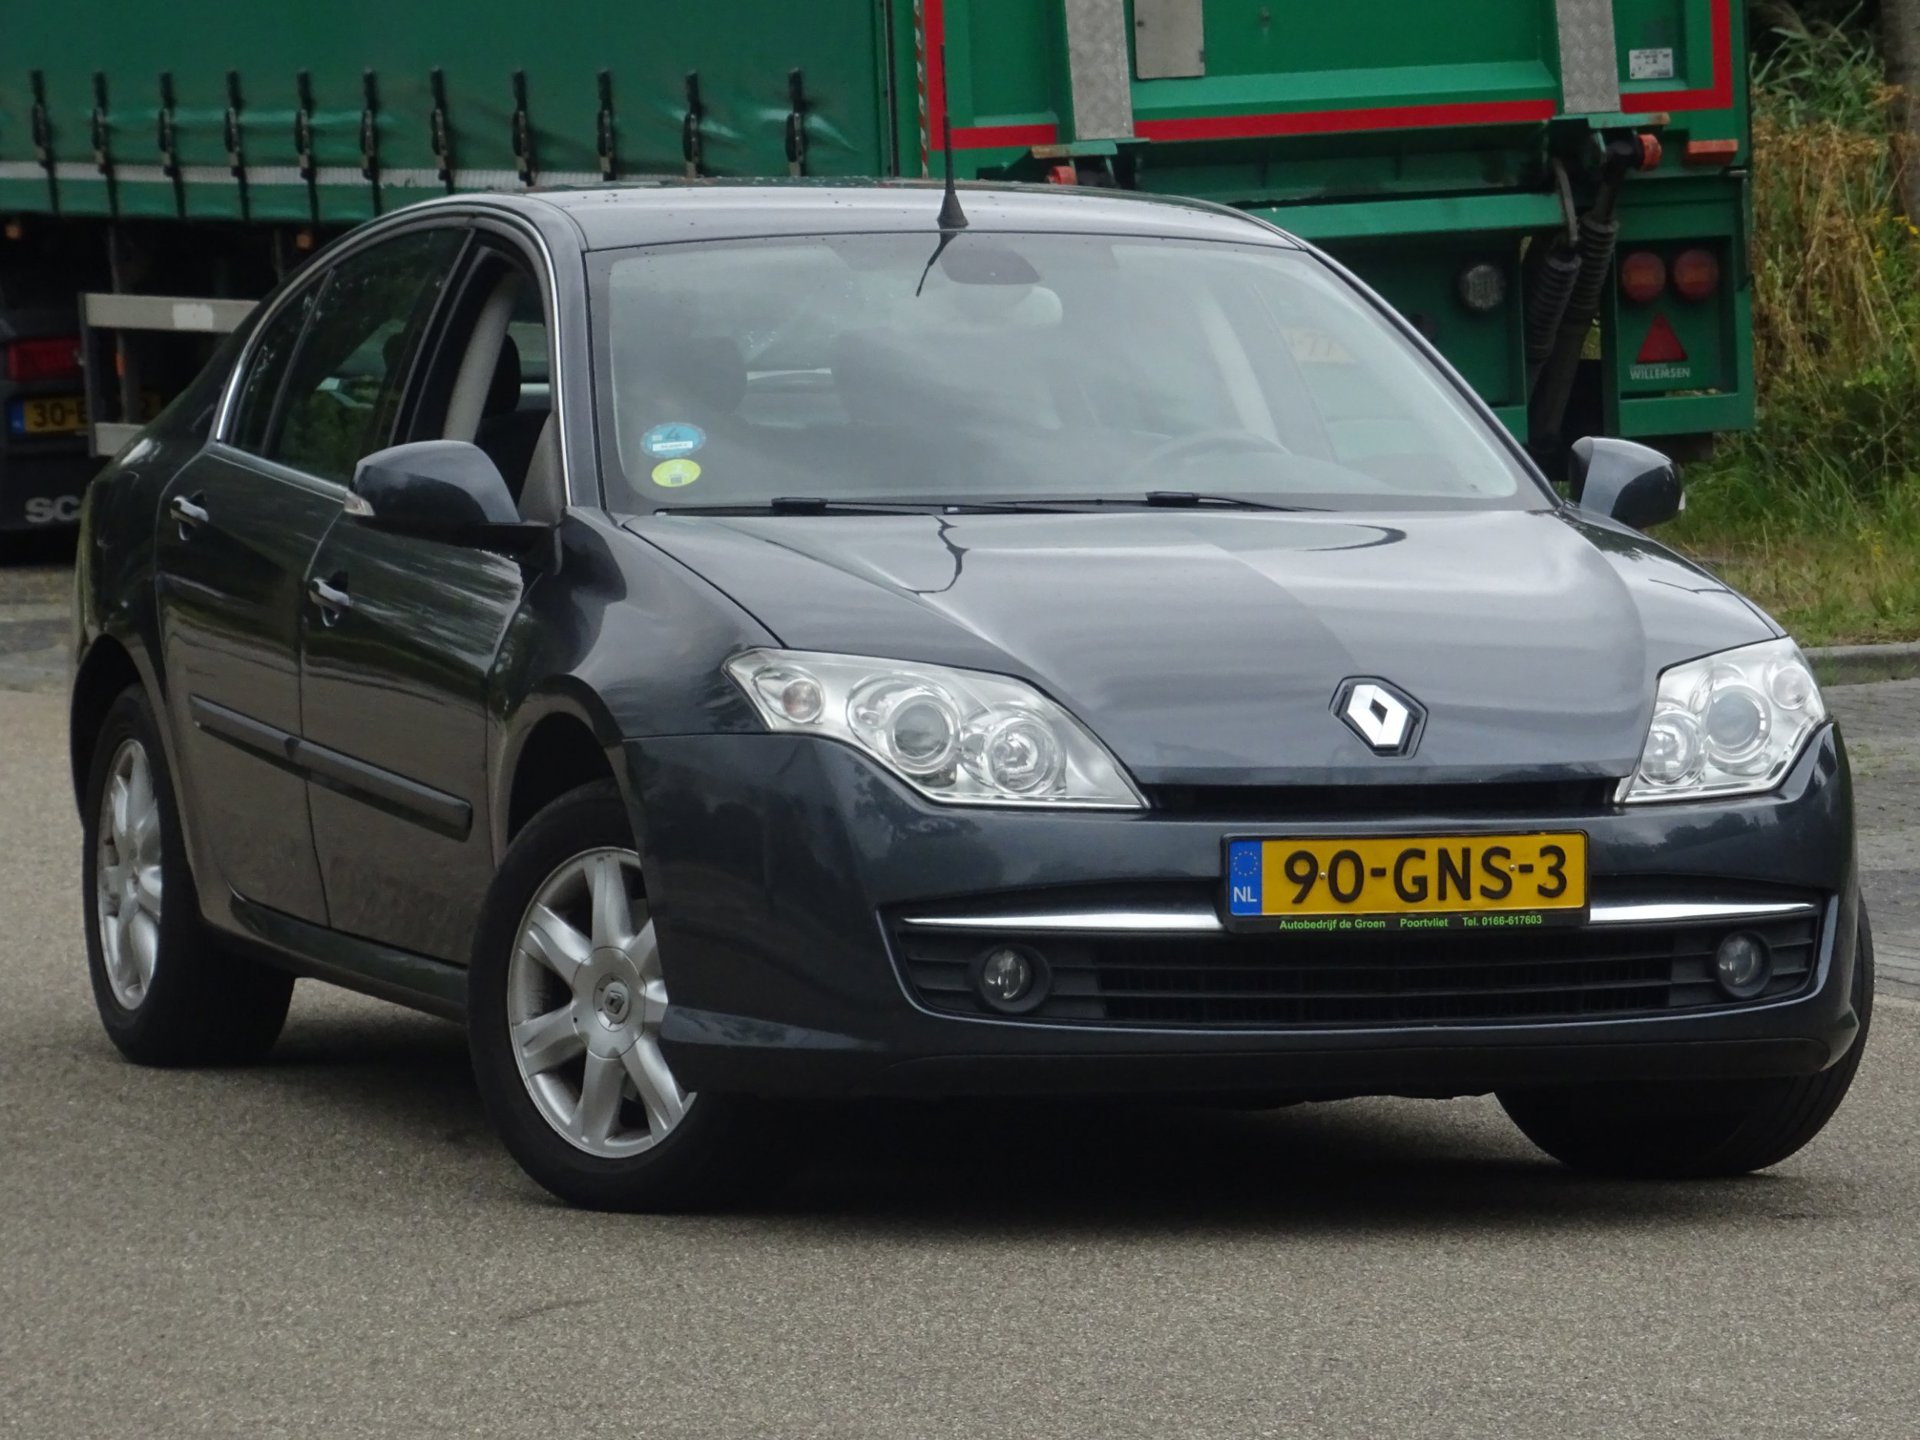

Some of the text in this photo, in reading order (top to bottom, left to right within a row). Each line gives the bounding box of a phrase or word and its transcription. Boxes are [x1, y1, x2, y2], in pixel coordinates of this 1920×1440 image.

[1630, 367, 1690, 379] WILLEMSEN
[1284, 845, 1567, 904] 90-GNS-3
[1233, 886, 1257, 902] NL
[1280, 915, 1542, 931] Autobedrijf de Groen Poortvliet Tel. 0166-617603
